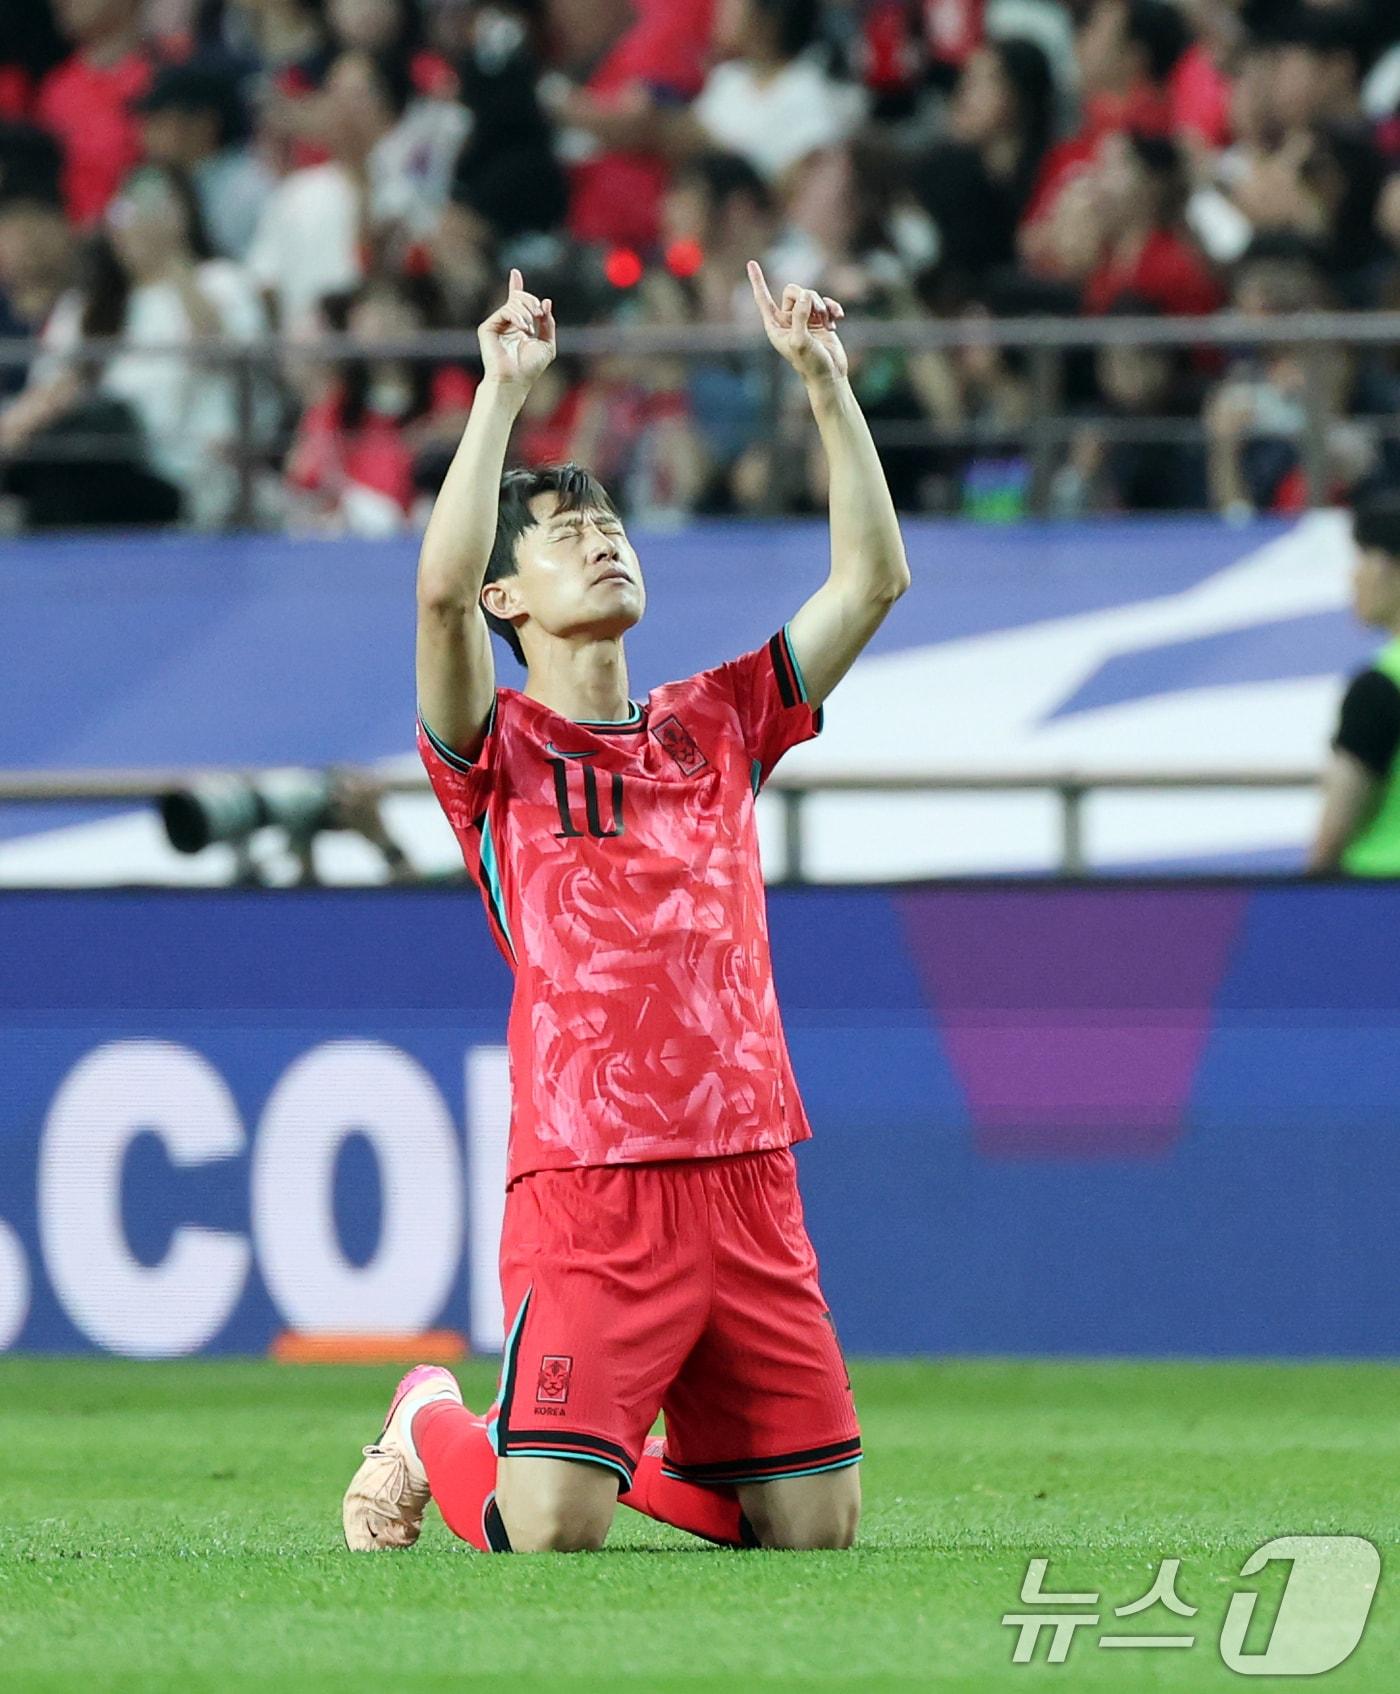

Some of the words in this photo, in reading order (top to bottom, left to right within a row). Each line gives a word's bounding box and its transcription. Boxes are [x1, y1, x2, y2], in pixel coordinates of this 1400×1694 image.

[544, 758, 624, 839] 10
[0, 1037, 512, 1359] CO
[534, 1407, 566, 1417] KOREA
